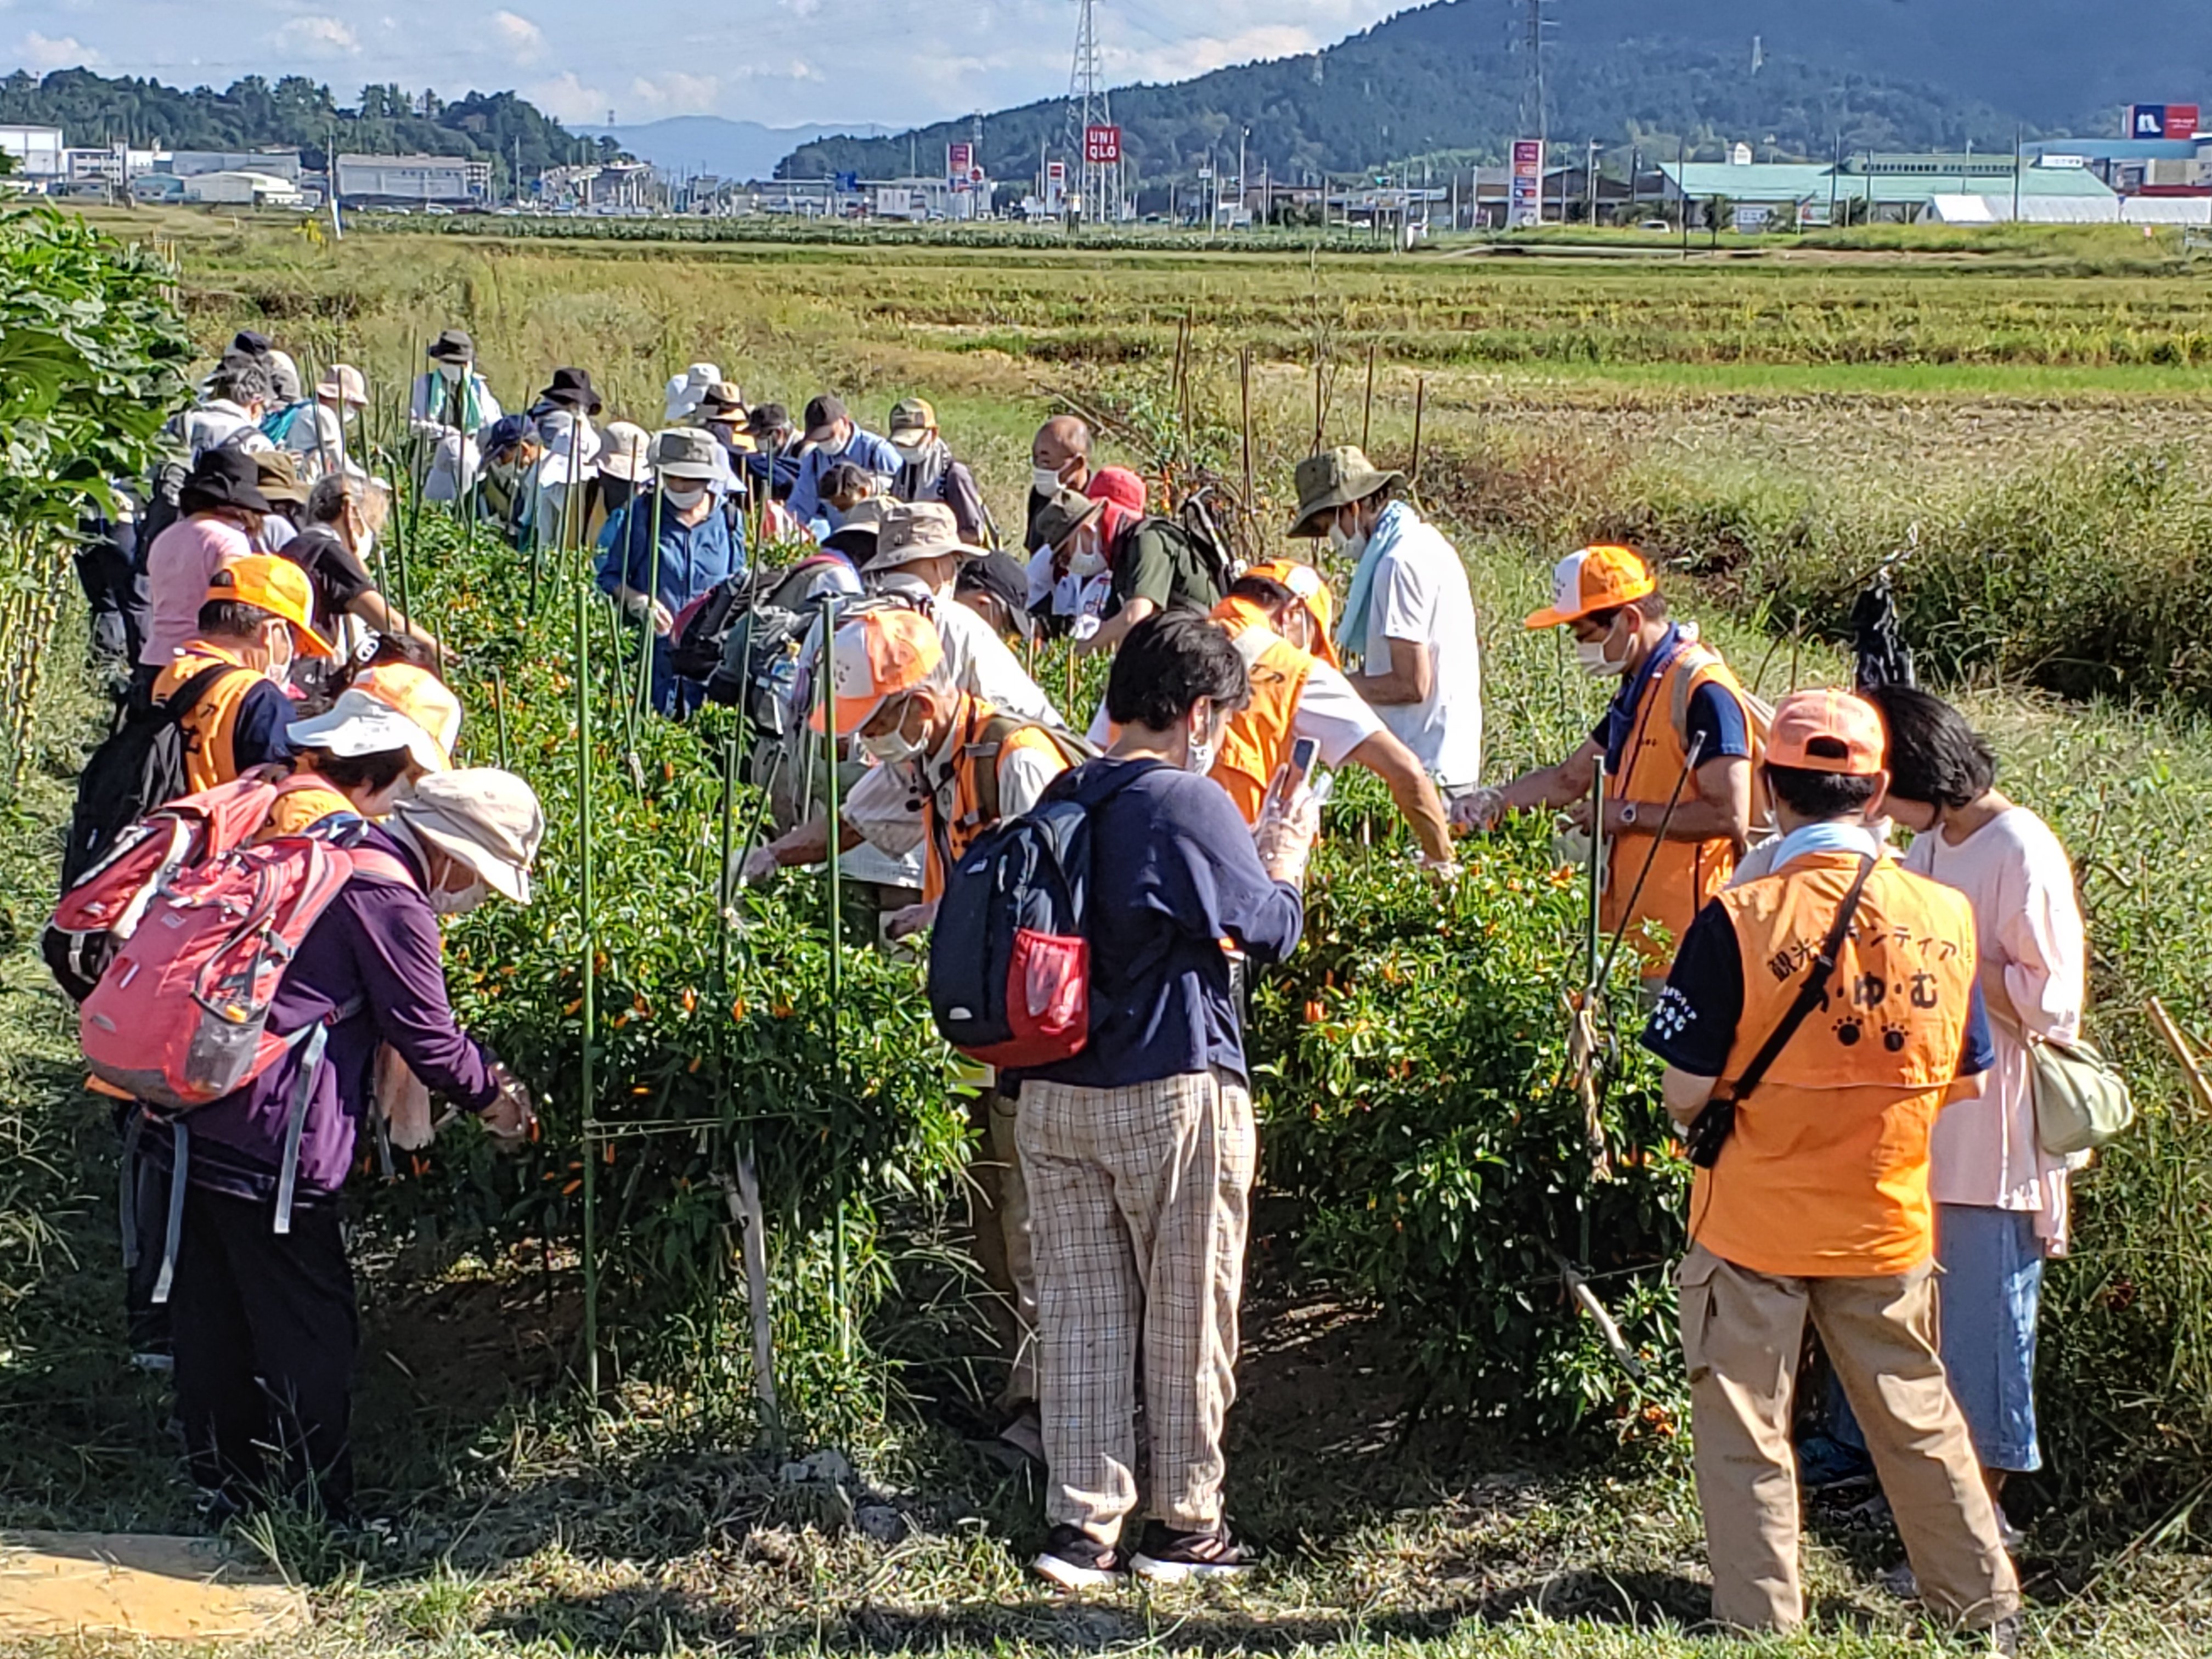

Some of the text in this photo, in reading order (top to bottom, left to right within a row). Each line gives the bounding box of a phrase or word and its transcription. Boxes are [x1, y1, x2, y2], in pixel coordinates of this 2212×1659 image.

[1089, 130, 1115, 144] UNI
[1089, 145, 1116, 160] QLO
[1767, 924, 1957, 983] 観光ランティア
